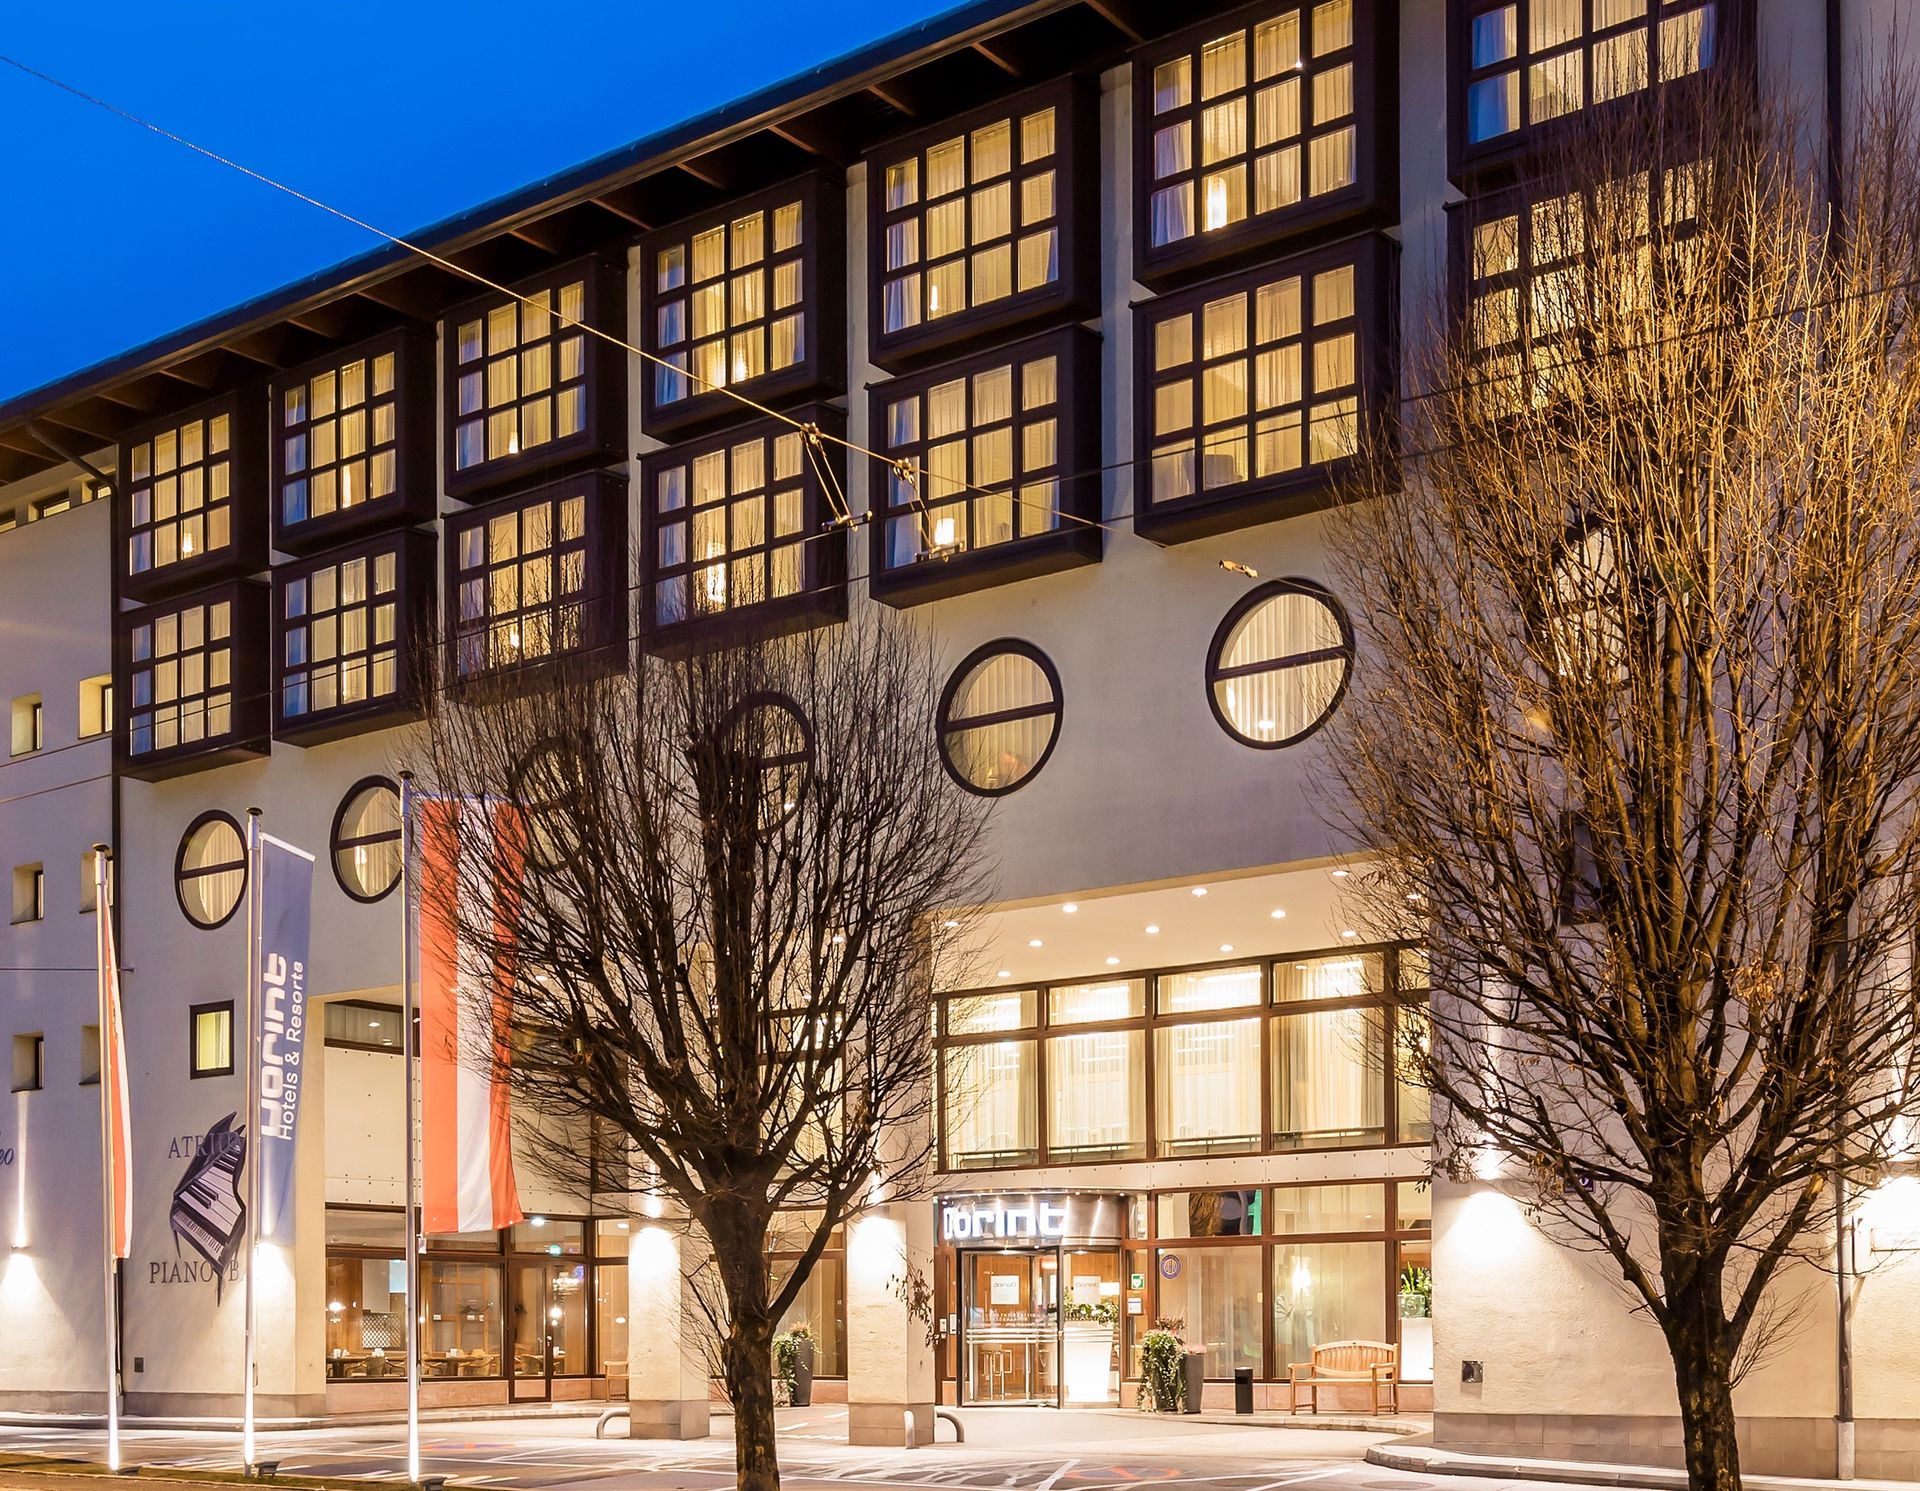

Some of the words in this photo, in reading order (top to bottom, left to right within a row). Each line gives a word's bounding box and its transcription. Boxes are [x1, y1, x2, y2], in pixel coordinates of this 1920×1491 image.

[286, 960, 304, 1043] Resorts
[284, 1051, 300, 1066] &
[277, 1072, 298, 1141] Hotels
[149, 1260, 214, 1284] PIANO
